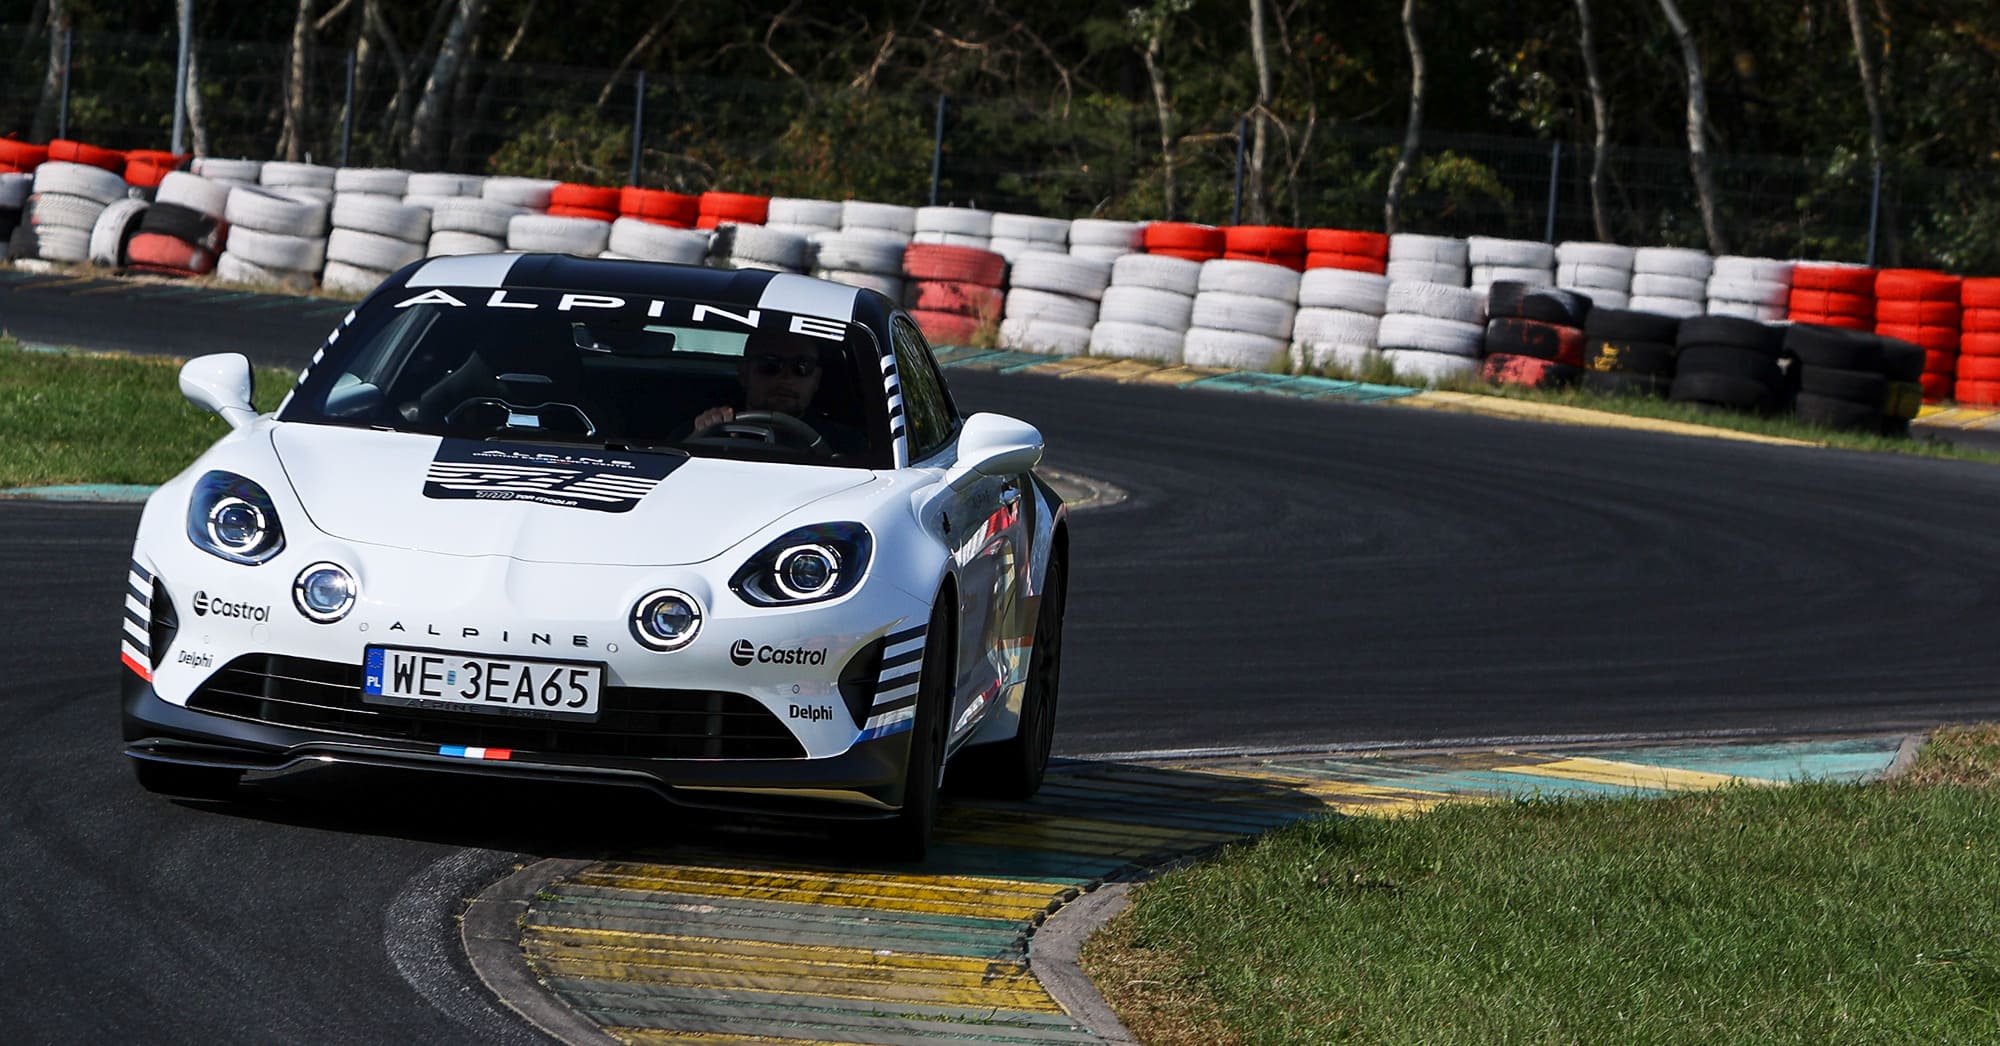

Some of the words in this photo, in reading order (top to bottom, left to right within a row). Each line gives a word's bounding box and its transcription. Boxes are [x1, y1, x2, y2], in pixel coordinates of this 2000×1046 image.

[394, 288, 847, 342] ALPINE
[482, 450, 631, 466] ALPINE
[211, 597, 271, 622] Castrol
[390, 621, 589, 647] ALPINE
[178, 650, 214, 668] Delphi
[757, 645, 827, 665] Castrol
[366, 676, 381, 688] PL
[393, 654, 444, 696] WE
[459, 661, 590, 708] 3EA65
[406, 699, 482, 713] ALPINE
[789, 704, 833, 722] Delphi
